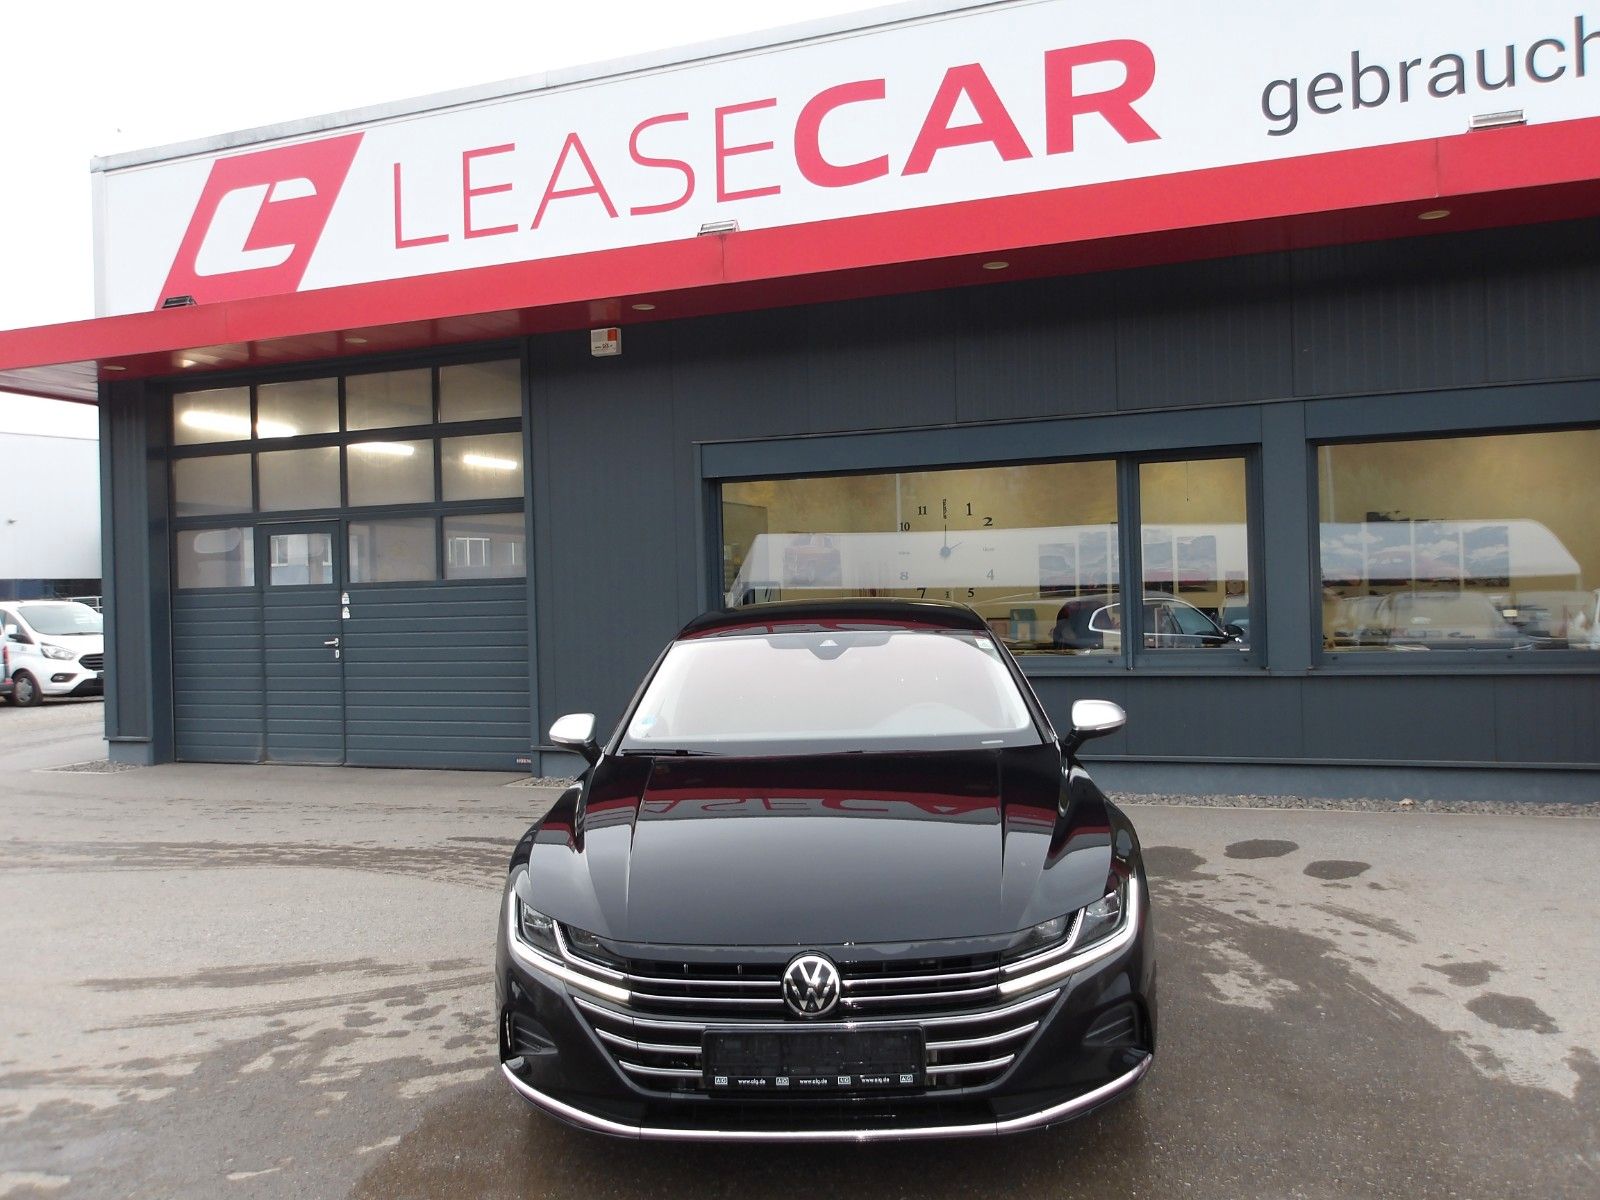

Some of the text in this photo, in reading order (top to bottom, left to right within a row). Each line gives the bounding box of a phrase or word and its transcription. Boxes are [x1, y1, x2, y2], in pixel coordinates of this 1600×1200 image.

[1261, 15, 1600, 137] gebrauch
[394, 40, 1158, 248] LEASECAR
[918, 505, 928, 516] 11
[966, 502, 973, 516] 1
[899, 522, 911, 532] 10
[983, 517, 993, 527] 2
[986, 569, 995, 581] 4
[916, 588, 927, 599] 7
[967, 588, 975, 598] 5
